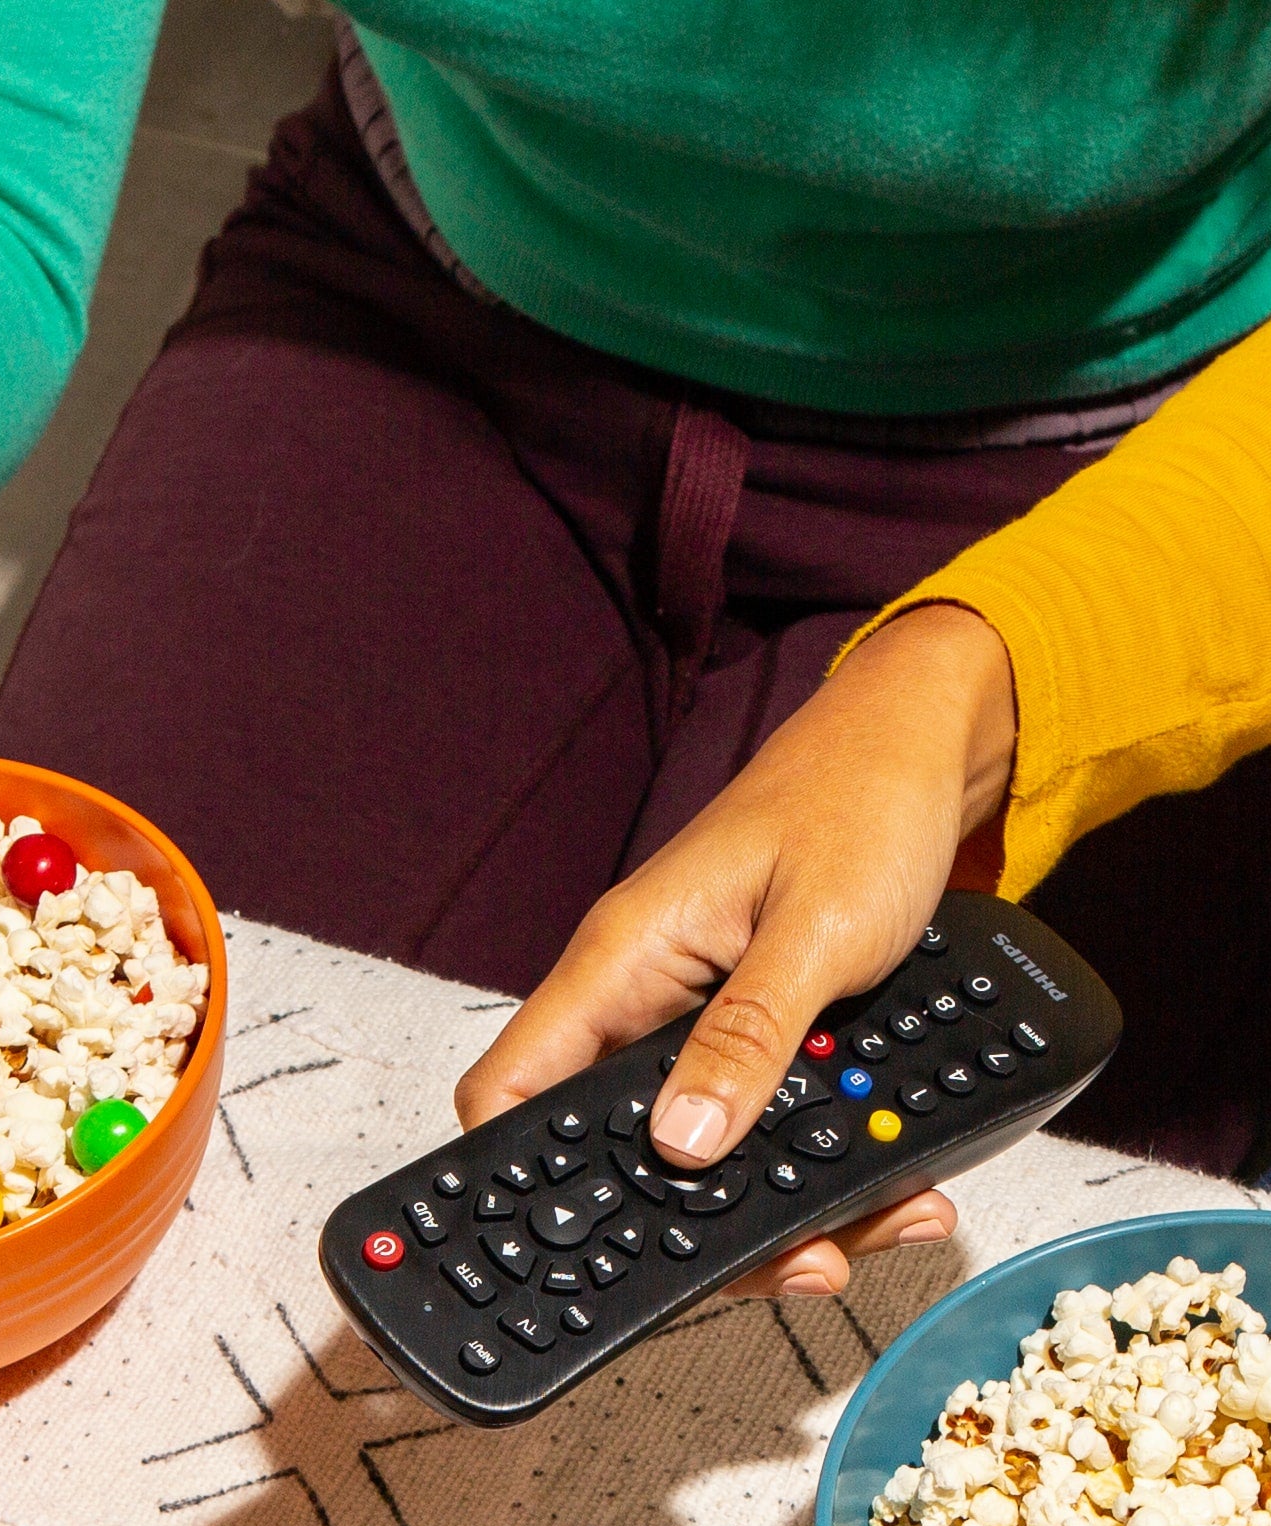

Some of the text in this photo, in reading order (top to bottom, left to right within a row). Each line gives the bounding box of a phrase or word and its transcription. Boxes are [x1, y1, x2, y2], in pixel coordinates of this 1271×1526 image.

[992, 933, 1068, 1001] PHILIPS
[935, 996, 955, 1011] 8
[898, 1015, 920, 1031] 5
[811, 1034, 827, 1047] C
[862, 1034, 884, 1051] 2
[1019, 1022, 1046, 1047] ENTER
[988, 1053, 1009, 1066] 7
[849, 1072, 866, 1086] B
[948, 1067, 968, 1083] 4
[776, 1088, 795, 1107] VO
[910, 1088, 927, 1101] 1
[811, 1130, 832, 1148] CH
[413, 1201, 439, 1228] AUD
[669, 1227, 694, 1250] SETUP
[455, 1262, 482, 1288] STR
[568, 1305, 590, 1326] MENU
[516, 1318, 538, 1336] TV
[468, 1340, 495, 1366] INPUT
